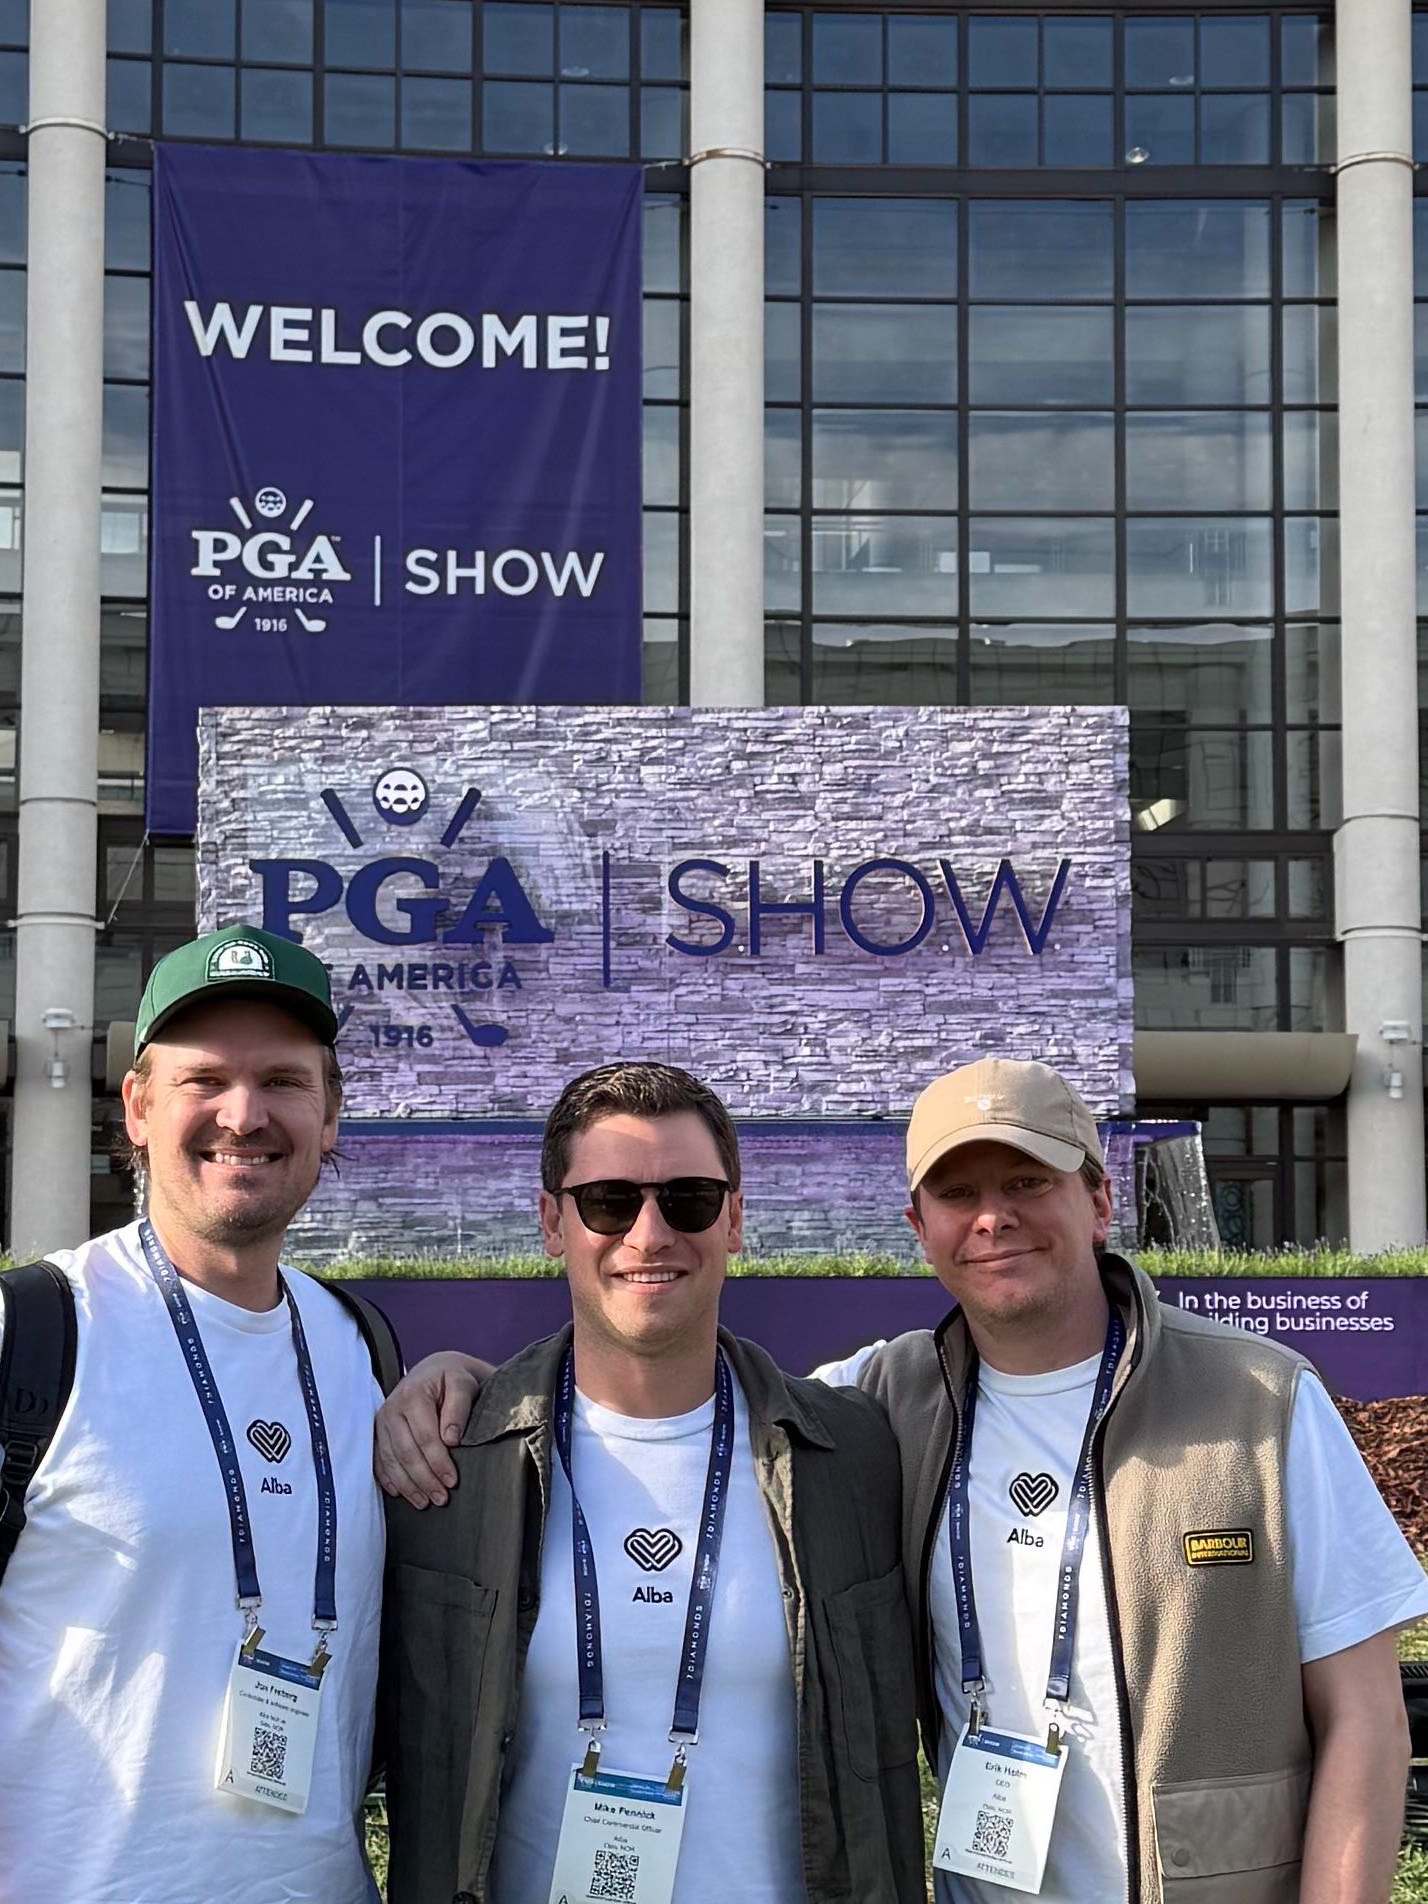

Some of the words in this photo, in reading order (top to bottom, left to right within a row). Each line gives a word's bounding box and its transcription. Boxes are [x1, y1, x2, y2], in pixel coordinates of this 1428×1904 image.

[184, 300, 610, 370] WELCOME!
[191, 530, 351, 581] PGA
[405, 550, 605, 597] SHOW
[208, 584, 236, 600] OF
[243, 586, 333, 603] AMERICA
[255, 618, 287, 632] 1916
[249, 856, 555, 945] PGA
[665, 858, 1072, 957] SHOW
[348, 962, 523, 990] AMERICA
[369, 1024, 434, 1047] 1916
[1179, 1291, 1199, 1309] In
[1204, 1291, 1241, 1309] the
[1247, 1291, 1342, 1310] business
[1346, 1291, 1370, 1310] of
[1208, 1312, 1270, 1335] ilding
[1275, 1312, 1395, 1331] businesses
[261, 1477, 292, 1496] Alba
[1006, 1527, 1044, 1548] Alba
[1191, 1537, 1247, 1552] BARBOUR
[632, 1586, 673, 1603] Alba
[225, 1770, 234, 1784] A
[985, 1762, 1002, 1774] Erik
[941, 1847, 951, 1861] A
